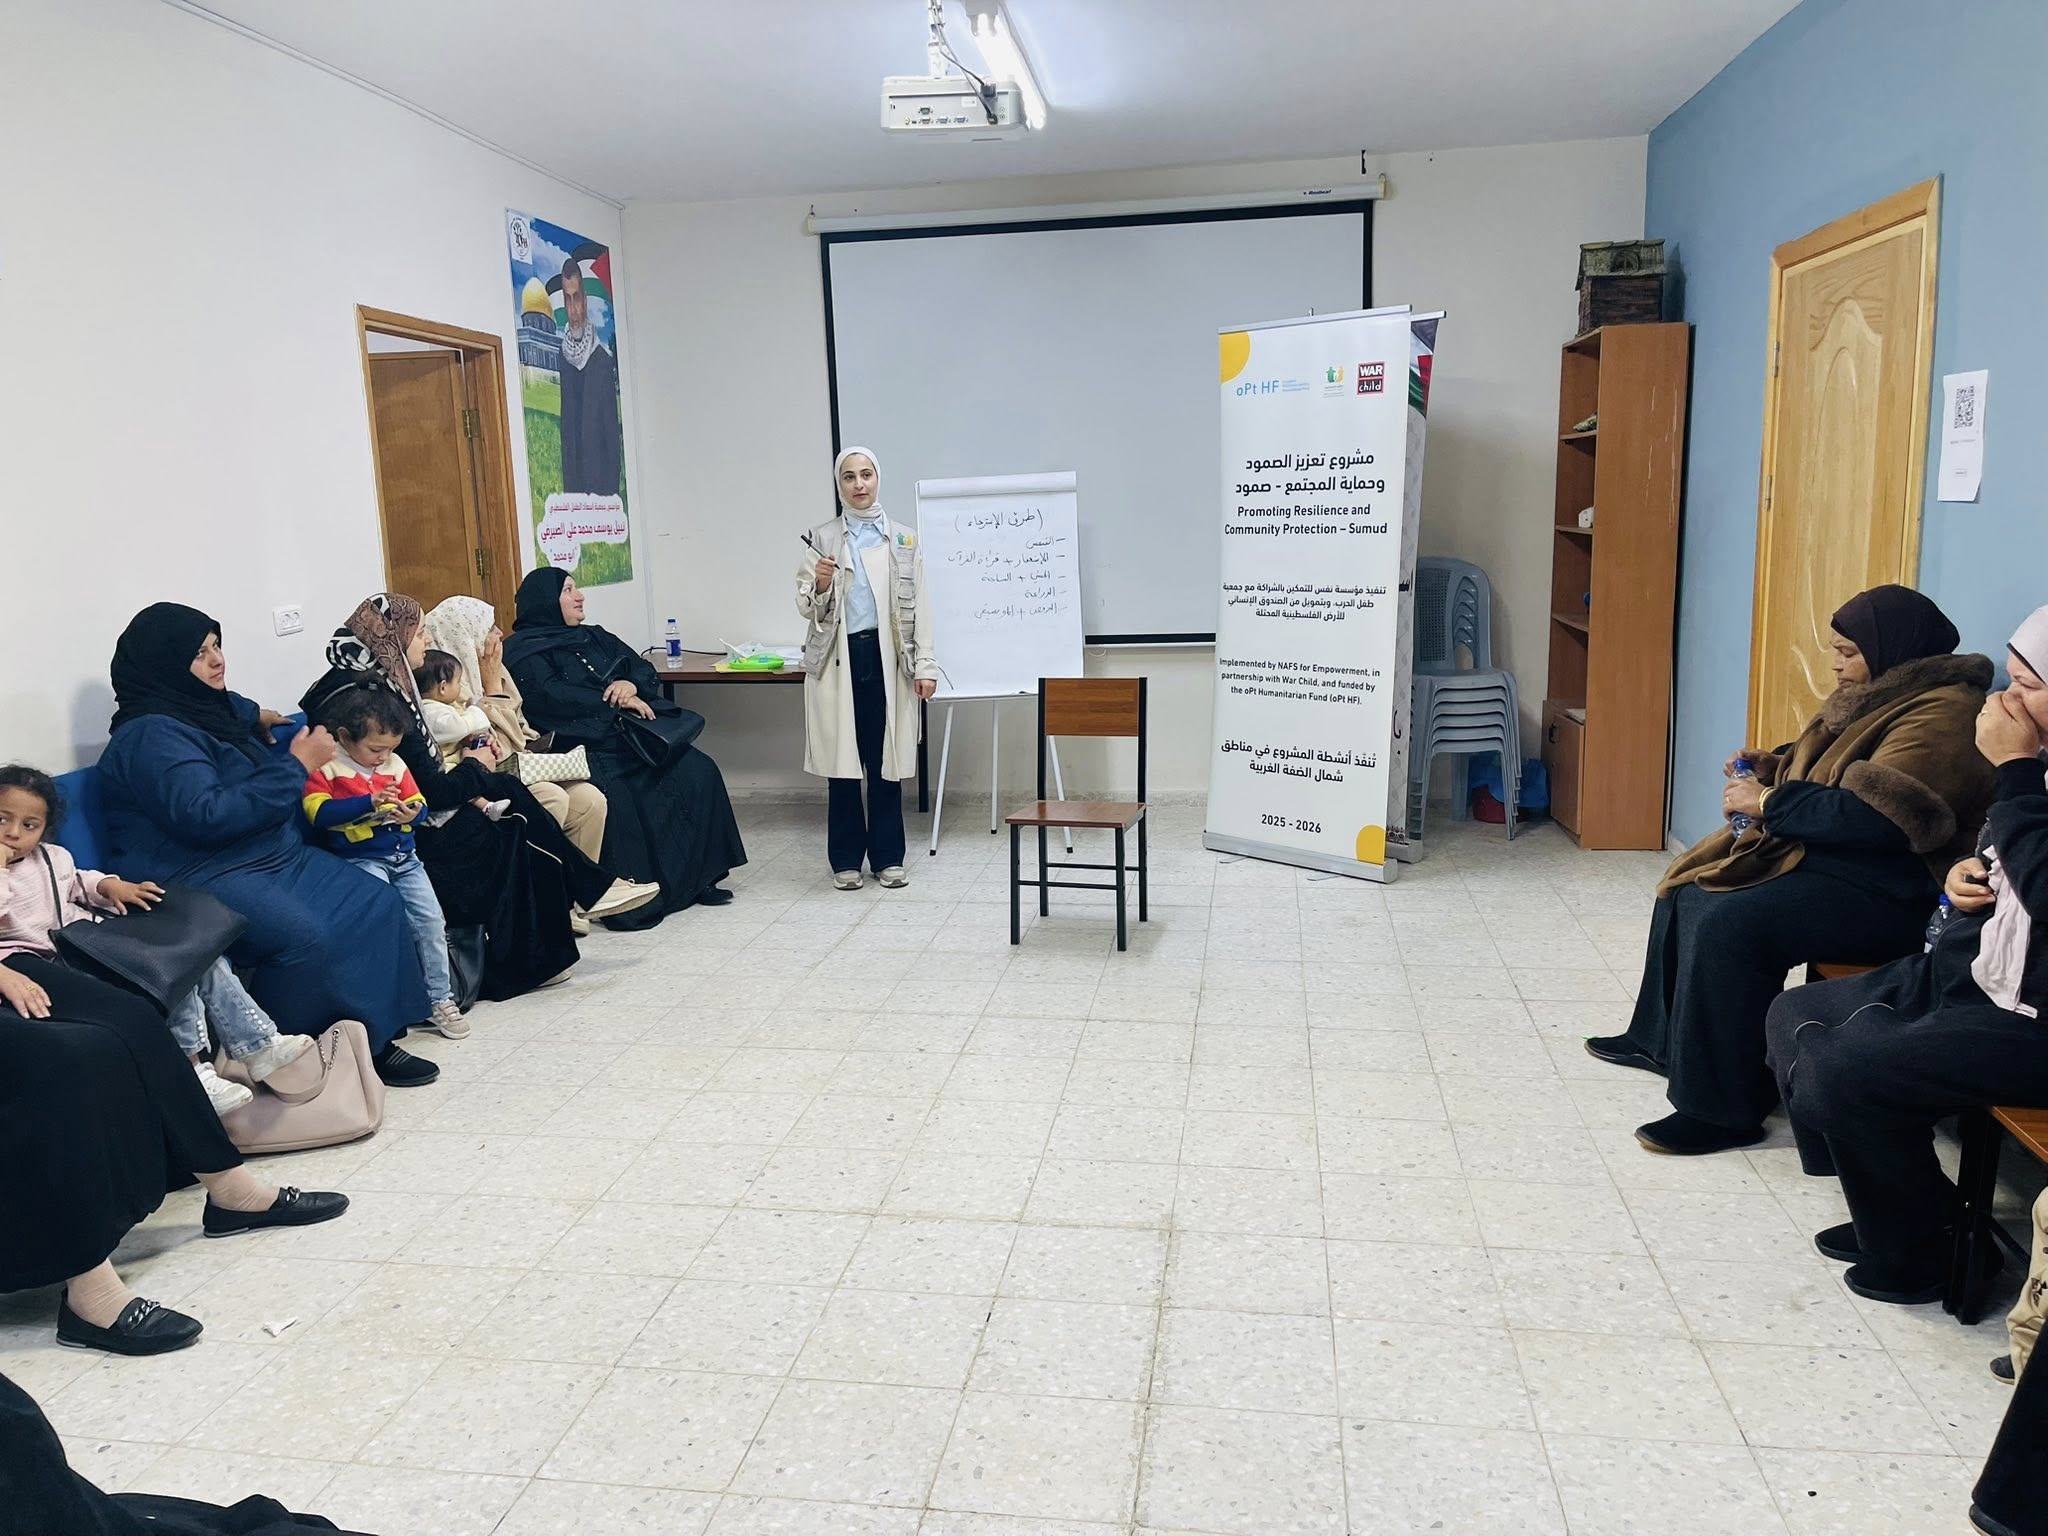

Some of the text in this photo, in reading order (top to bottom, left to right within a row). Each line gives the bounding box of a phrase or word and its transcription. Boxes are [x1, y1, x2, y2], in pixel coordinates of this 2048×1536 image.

[1359, 365, 1383, 377] WAR
[1236, 382, 1258, 397] oPt
[1261, 380, 1279, 394] HF
[1358, 381, 1382, 392] child
[1246, 448, 1374, 473] مشروع تعزيز الصمود
[1235, 483, 1271, 496] صمود
[1285, 476, 1336, 495] المجتمع
[1340, 475, 1385, 494] وحماية
[1238, 504, 1371, 519] Promoting Resilience and
[1224, 523, 1280, 537] Community
[1283, 523, 1337, 534] Protection
[1349, 522, 1388, 534] Sumud
[1223, 582, 1387, 596] تنفيذ مؤسسة نفس للتمكين بالشراكة مع جمعية
[1228, 595, 1257, 607] الإنساني
[1258, 596, 1288, 606] الصندوق
[1290, 598, 1300, 607] من
[1301, 597, 1331, 608] وبتمويل
[1356, 599, 1374, 609] طفل
[1255, 608, 1345, 622] للأرض الفلسطينية المحتلة
[1220, 658, 1266, 669] Implemented
[1267, 661, 1276, 670] by
[1278, 662, 1298, 671] NAFS
[1300, 663, 1311, 671] for
[1372, 668, 1380, 677] in
[1221, 673, 1376, 692] partnership with War Child, and funded by
[1231, 686, 1362, 705] the oPt Humanitarian Fund (oPt HF).
[1221, 739, 1252, 752] مناطق
[1255, 744, 1270, 759] في
[1272, 746, 1314, 760] المشروع
[1317, 750, 1351, 765] أنشطة
[1250, 760, 1343, 782] شمال الضفة الغربية
[1261, 814, 1286, 828] 2025
[1296, 820, 1322, 833] 2026
